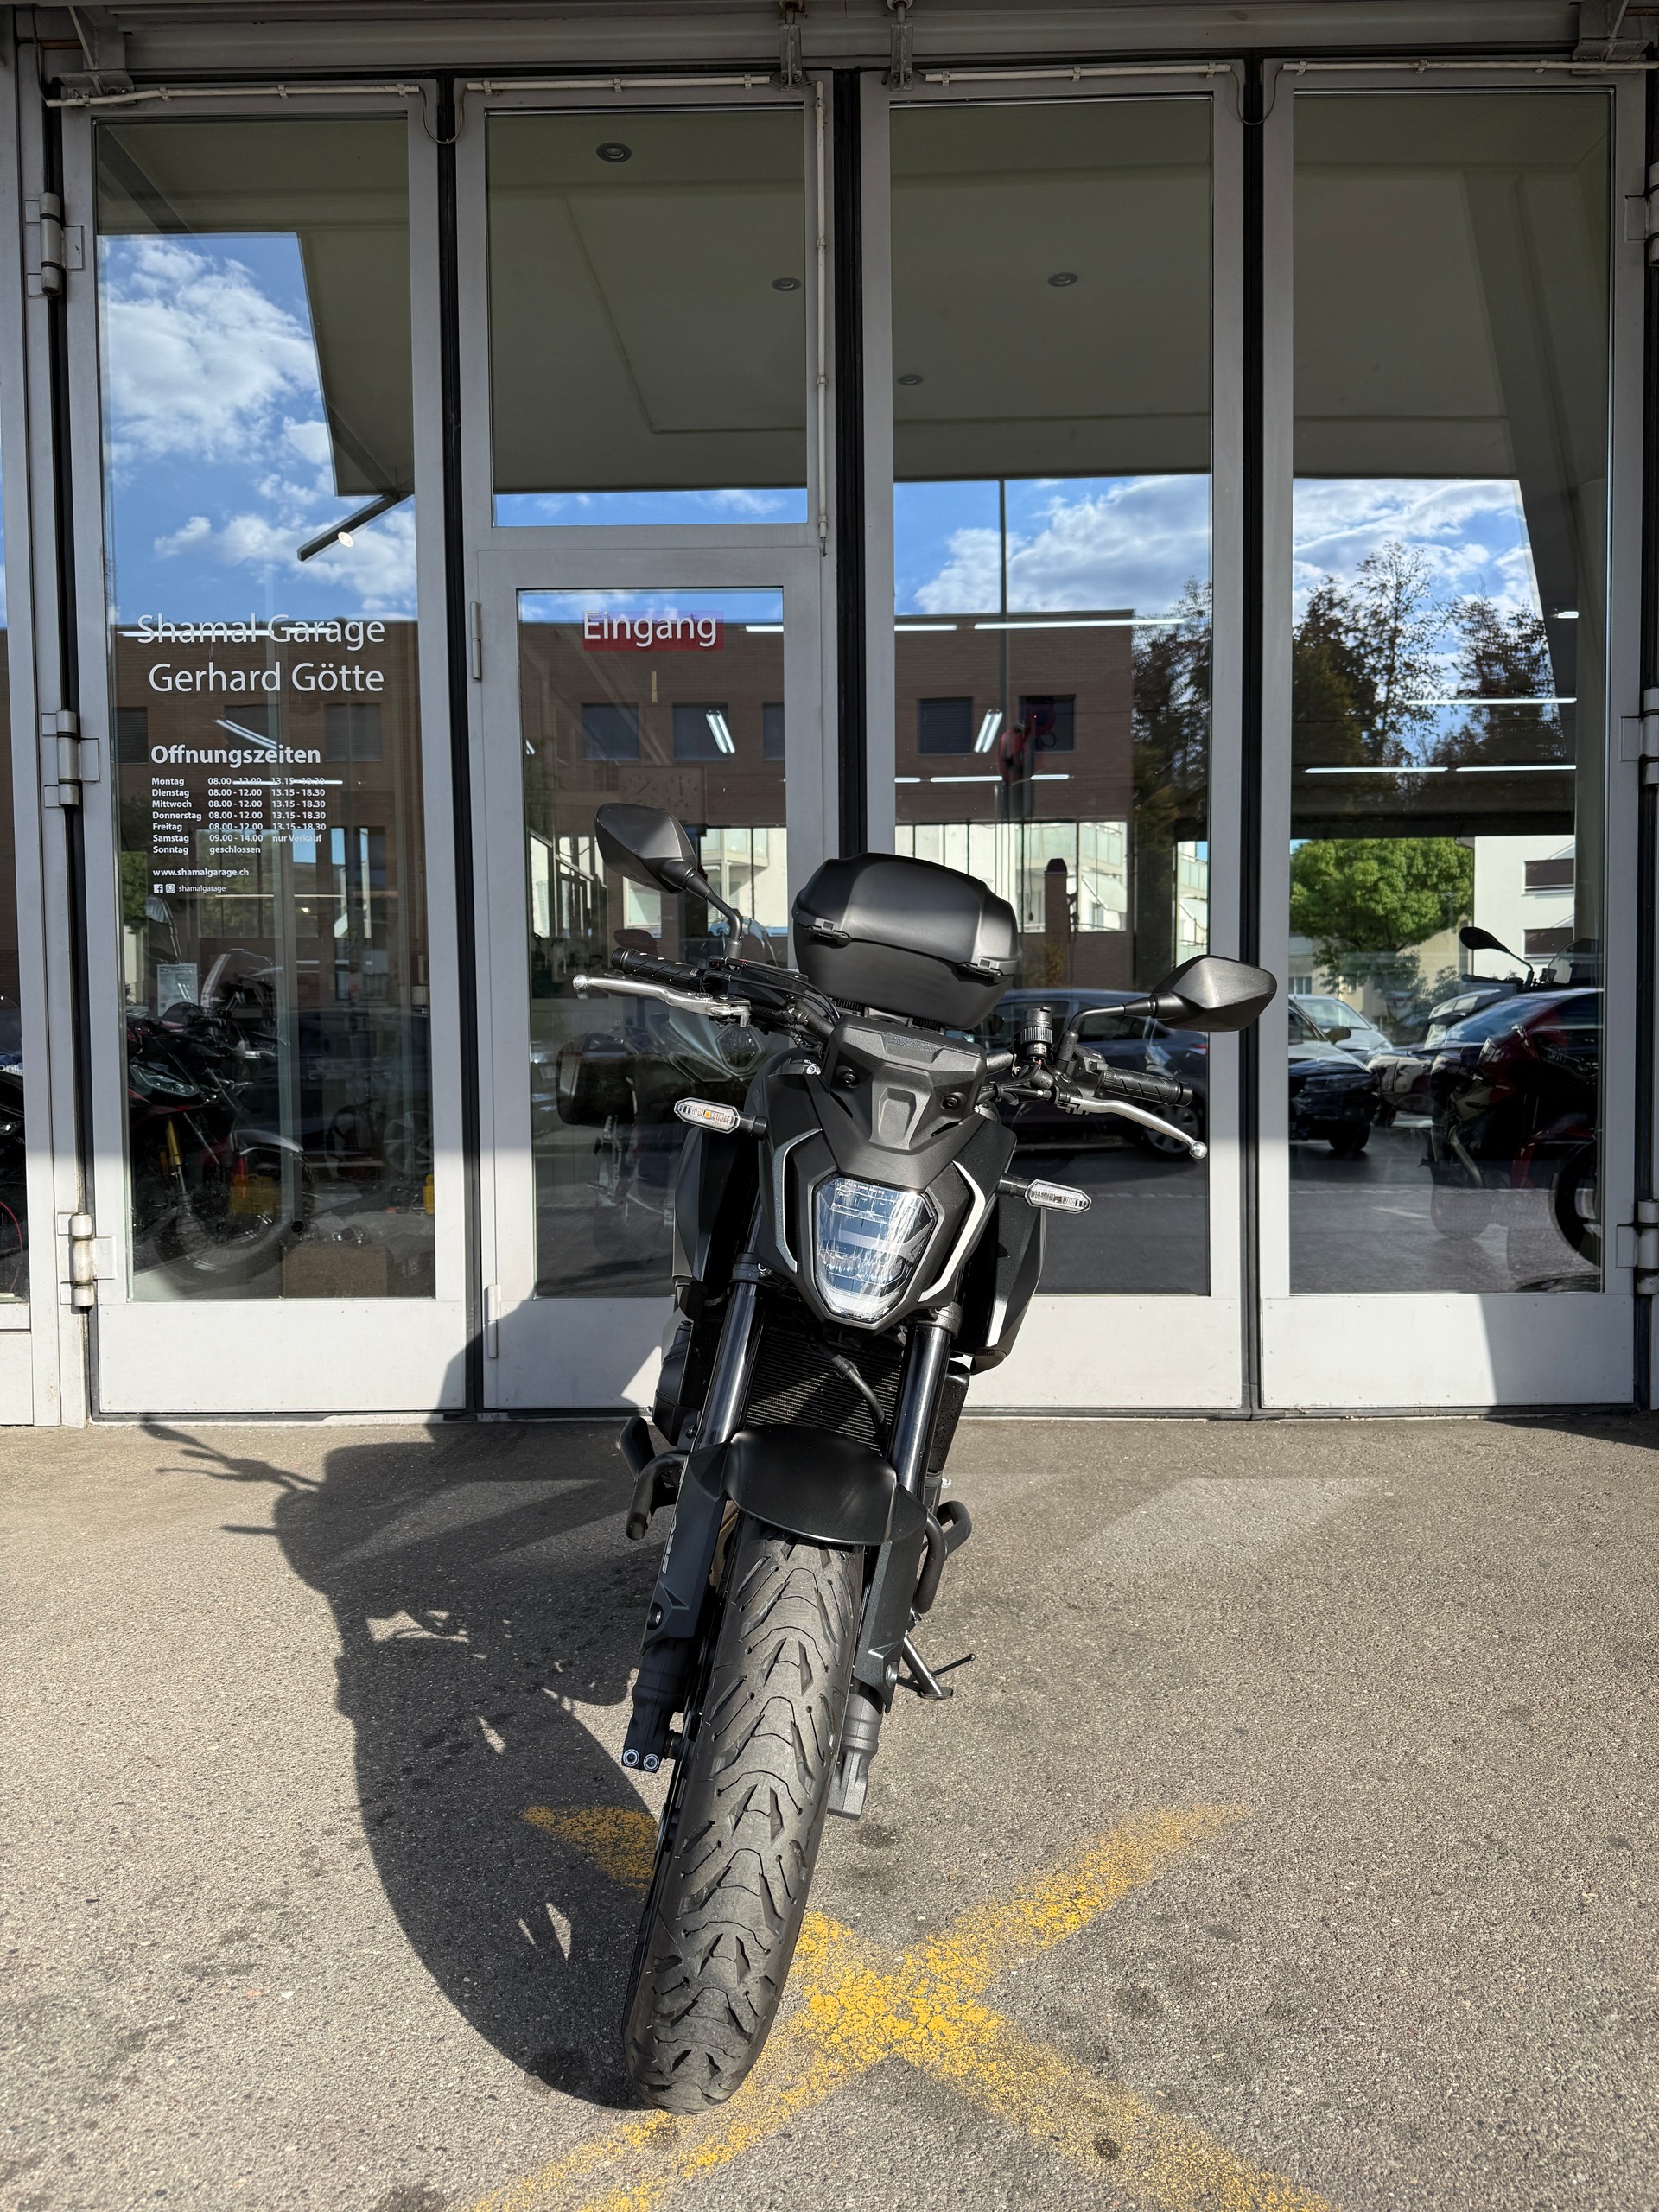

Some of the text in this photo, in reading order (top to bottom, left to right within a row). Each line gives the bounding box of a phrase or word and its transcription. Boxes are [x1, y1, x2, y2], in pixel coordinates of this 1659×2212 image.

[137, 613, 385, 651] Shamal Garage
[583, 610, 716, 647] Eingang
[148, 661, 385, 692] Gerhard Götte
[151, 777, 185, 787] Montag
[207, 777, 232, 785] 08.00
[151, 788, 190, 798] Dienstag
[207, 788, 232, 797] 08.00
[238, 788, 263, 797] 12.00
[271, 788, 296, 797] 13.15
[302, 788, 326, 797] 18.30
[152, 799, 192, 808] Mittwoch
[207, 799, 232, 808] 08.00
[238, 799, 263, 808] 12.00
[271, 799, 296, 808] 13.15
[302, 799, 326, 808] 18.30
[152, 810, 202, 822] Donnerstag
[208, 811, 233, 820] 08.00
[239, 811, 264, 820] 12.00
[272, 811, 296, 820] 13.15
[302, 811, 327, 820] 18.30
[152, 822, 183, 833] Freitag
[208, 823, 233, 831] 08.00
[239, 823, 264, 831] 12.00
[272, 823, 296, 831] 13.15
[302, 823, 327, 831] 18.30
[152, 834, 189, 844] Samstag
[209, 834, 233, 842] 09.00
[239, 834, 264, 842] 14.00
[288, 834, 322, 842] Verkauf
[152, 845, 261, 855] Sonntag geschlossen
[152, 868, 250, 878] www.shamalgarage.ch
[178, 884, 226, 893] shamalgarage
